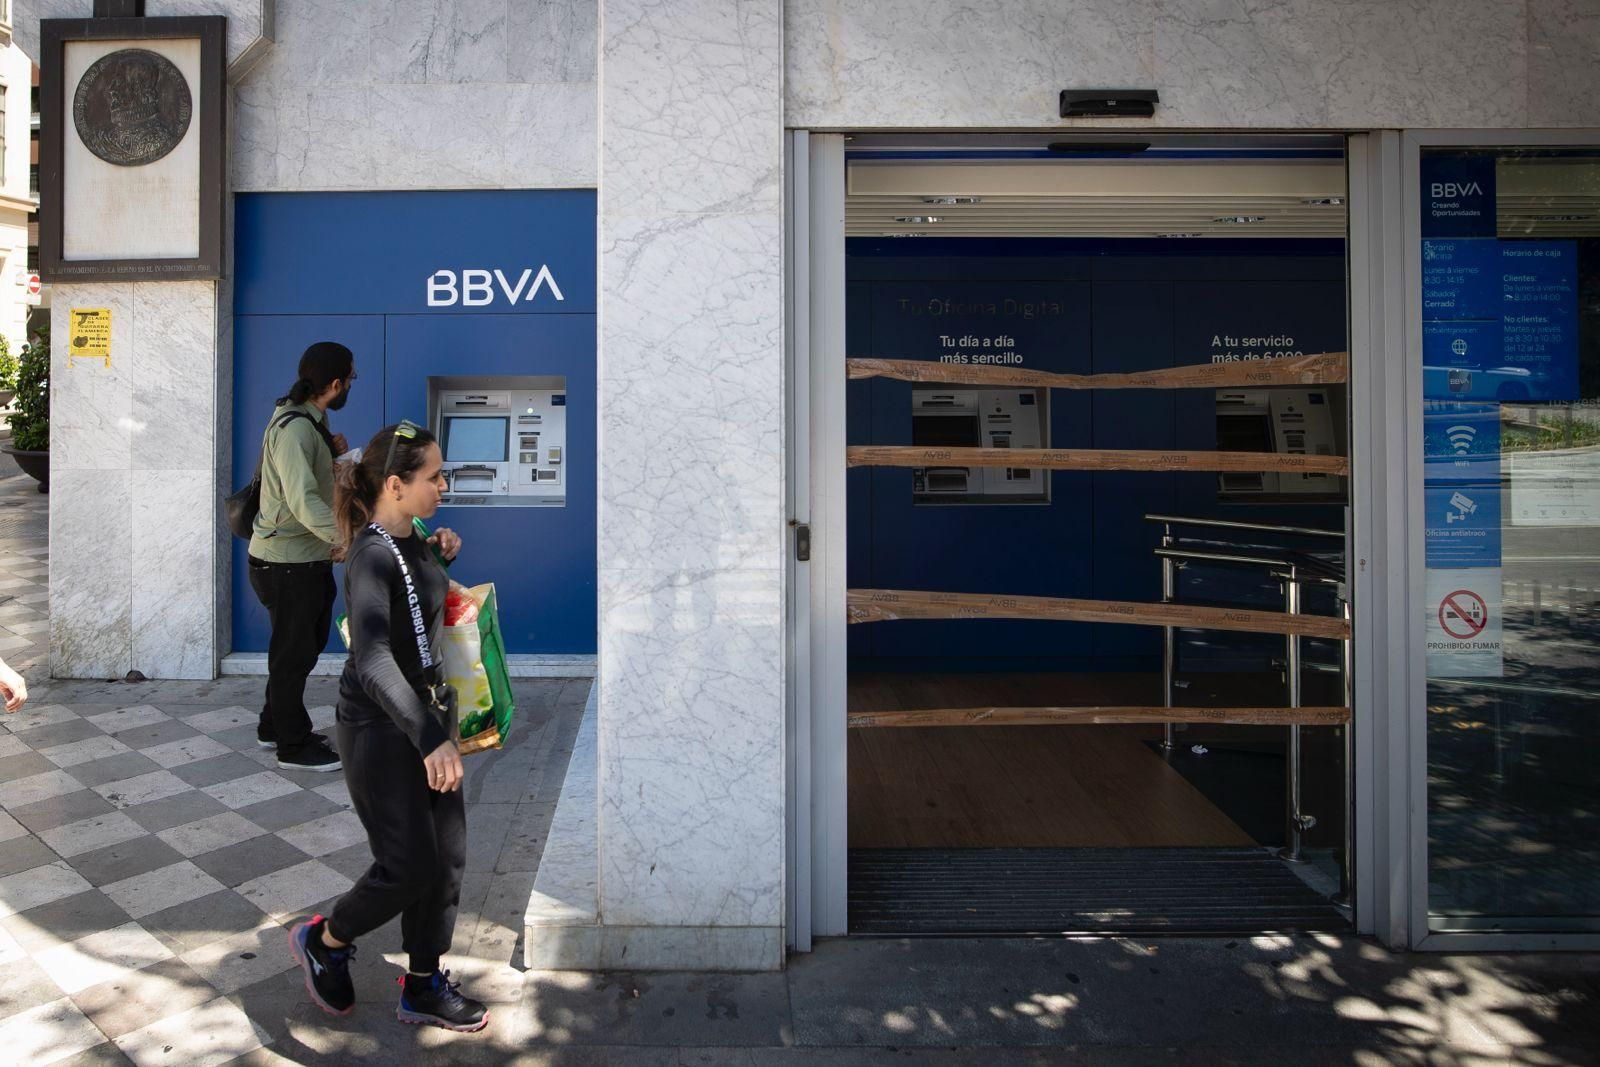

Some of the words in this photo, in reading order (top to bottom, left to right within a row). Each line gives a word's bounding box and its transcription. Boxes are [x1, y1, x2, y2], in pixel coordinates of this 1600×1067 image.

[1431, 182, 1483, 198] BBVA
[1432, 201, 1460, 209] Creando
[1432, 209, 1481, 217] Oportunidades
[1503, 249, 1532, 257] Horario
[1534, 249, 1544, 257] de
[1545, 249, 1562, 258] caja
[1424, 266, 1446, 274] Lunes
[1503, 274, 1537, 282] Clientes:
[427, 264, 564, 307] BBVA
[1424, 300, 1455, 308] Cerrado
[928, 298, 996, 316] Oficina
[1004, 298, 1065, 320] Digital
[1504, 315, 1515, 323] No
[1504, 325, 1530, 333] Martes
[940, 335, 955, 347] Tu
[959, 335, 979, 347] día
[983, 338, 991, 347] a
[994, 335, 1015, 347] día
[1211, 335, 1221, 347] A
[1224, 336, 1238, 347] tu
[1242, 334, 1294, 347] servicio
[940, 352, 968, 364] más
[972, 352, 1023, 364] sencillo
[1212, 351, 1240, 364] más
